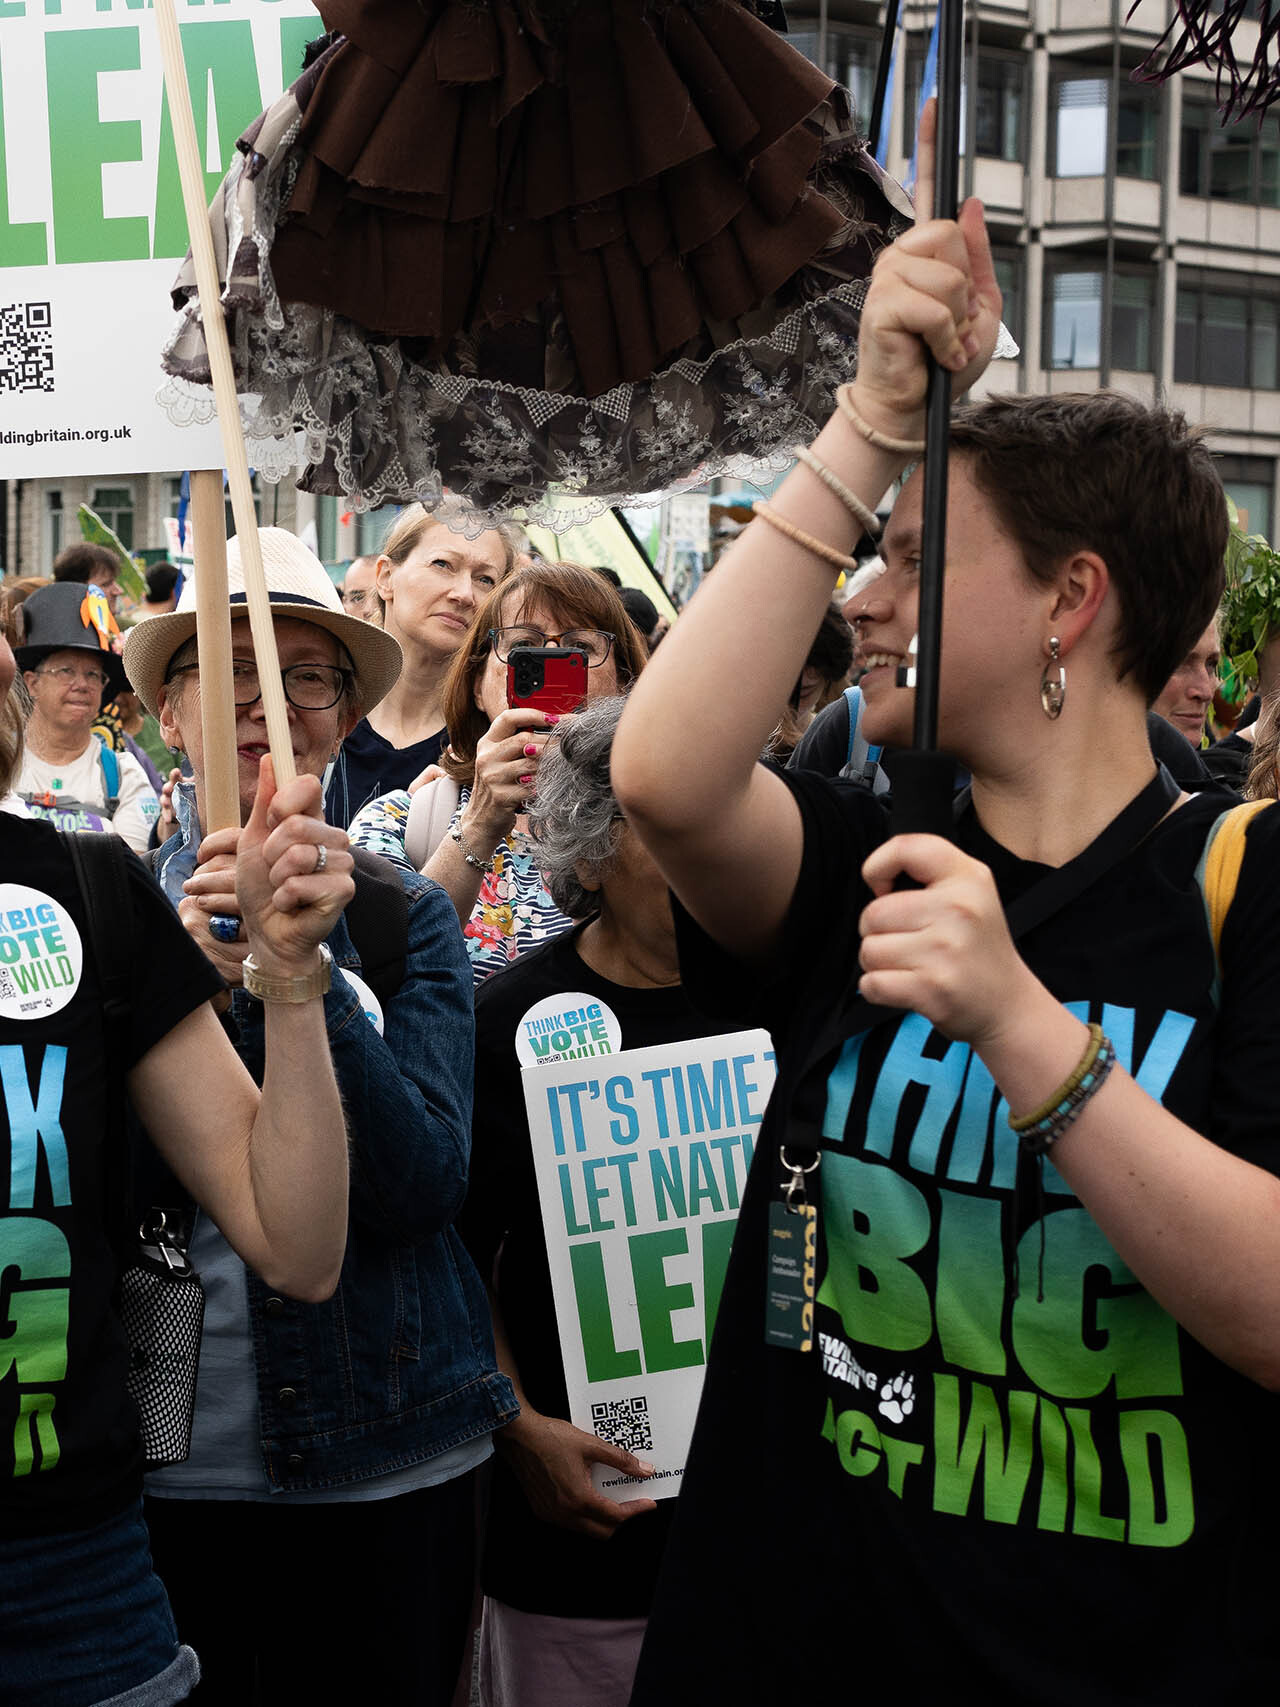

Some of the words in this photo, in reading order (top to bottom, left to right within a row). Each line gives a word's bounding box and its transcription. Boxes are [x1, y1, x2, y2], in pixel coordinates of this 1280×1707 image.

[7, 904, 57, 931] BIG
[10, 955, 74, 995] WILD
[523, 1013, 565, 1037] THINK
[563, 1003, 602, 1027] BIG
[528, 1019, 609, 1058] VOTE
[546, 1074, 640, 1156] IT'S
[641, 1054, 763, 1141] TIME
[558, 1151, 640, 1237] LET
[649, 1133, 757, 1222] NAT
[568, 1218, 740, 1384] LE
[815, 1149, 1184, 1401] BIG
[932, 1373, 1196, 1548] WILD
